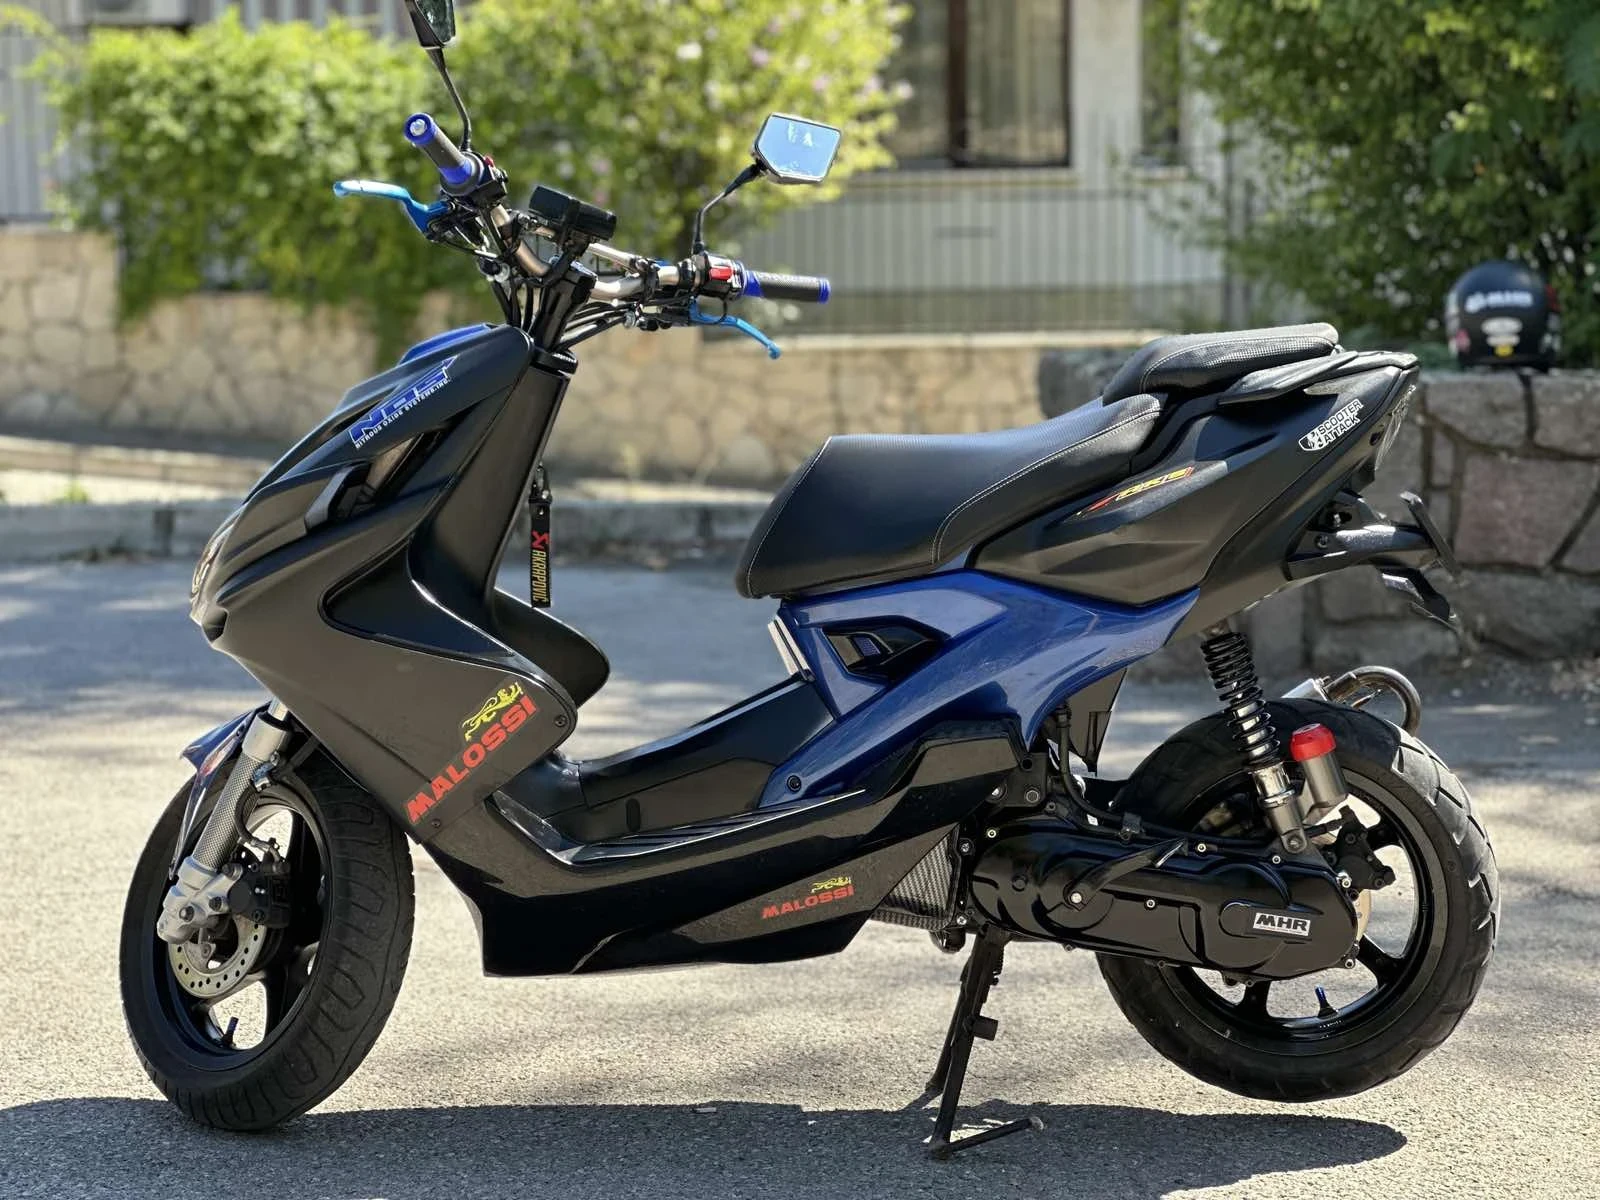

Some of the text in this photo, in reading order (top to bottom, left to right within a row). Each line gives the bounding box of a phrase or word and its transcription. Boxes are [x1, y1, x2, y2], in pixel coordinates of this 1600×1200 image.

[349, 355, 458, 444] NOS
[354, 425, 383, 449] NITROUS
[382, 409, 404, 427] OXIDE
[1317, 400, 1363, 435] SCOOTER
[1324, 414, 1360, 443] ATTACK
[407, 695, 537, 824] MALOSSI
[762, 885, 855, 919] MALOSSI
[1255, 914, 1308, 932] MHR
